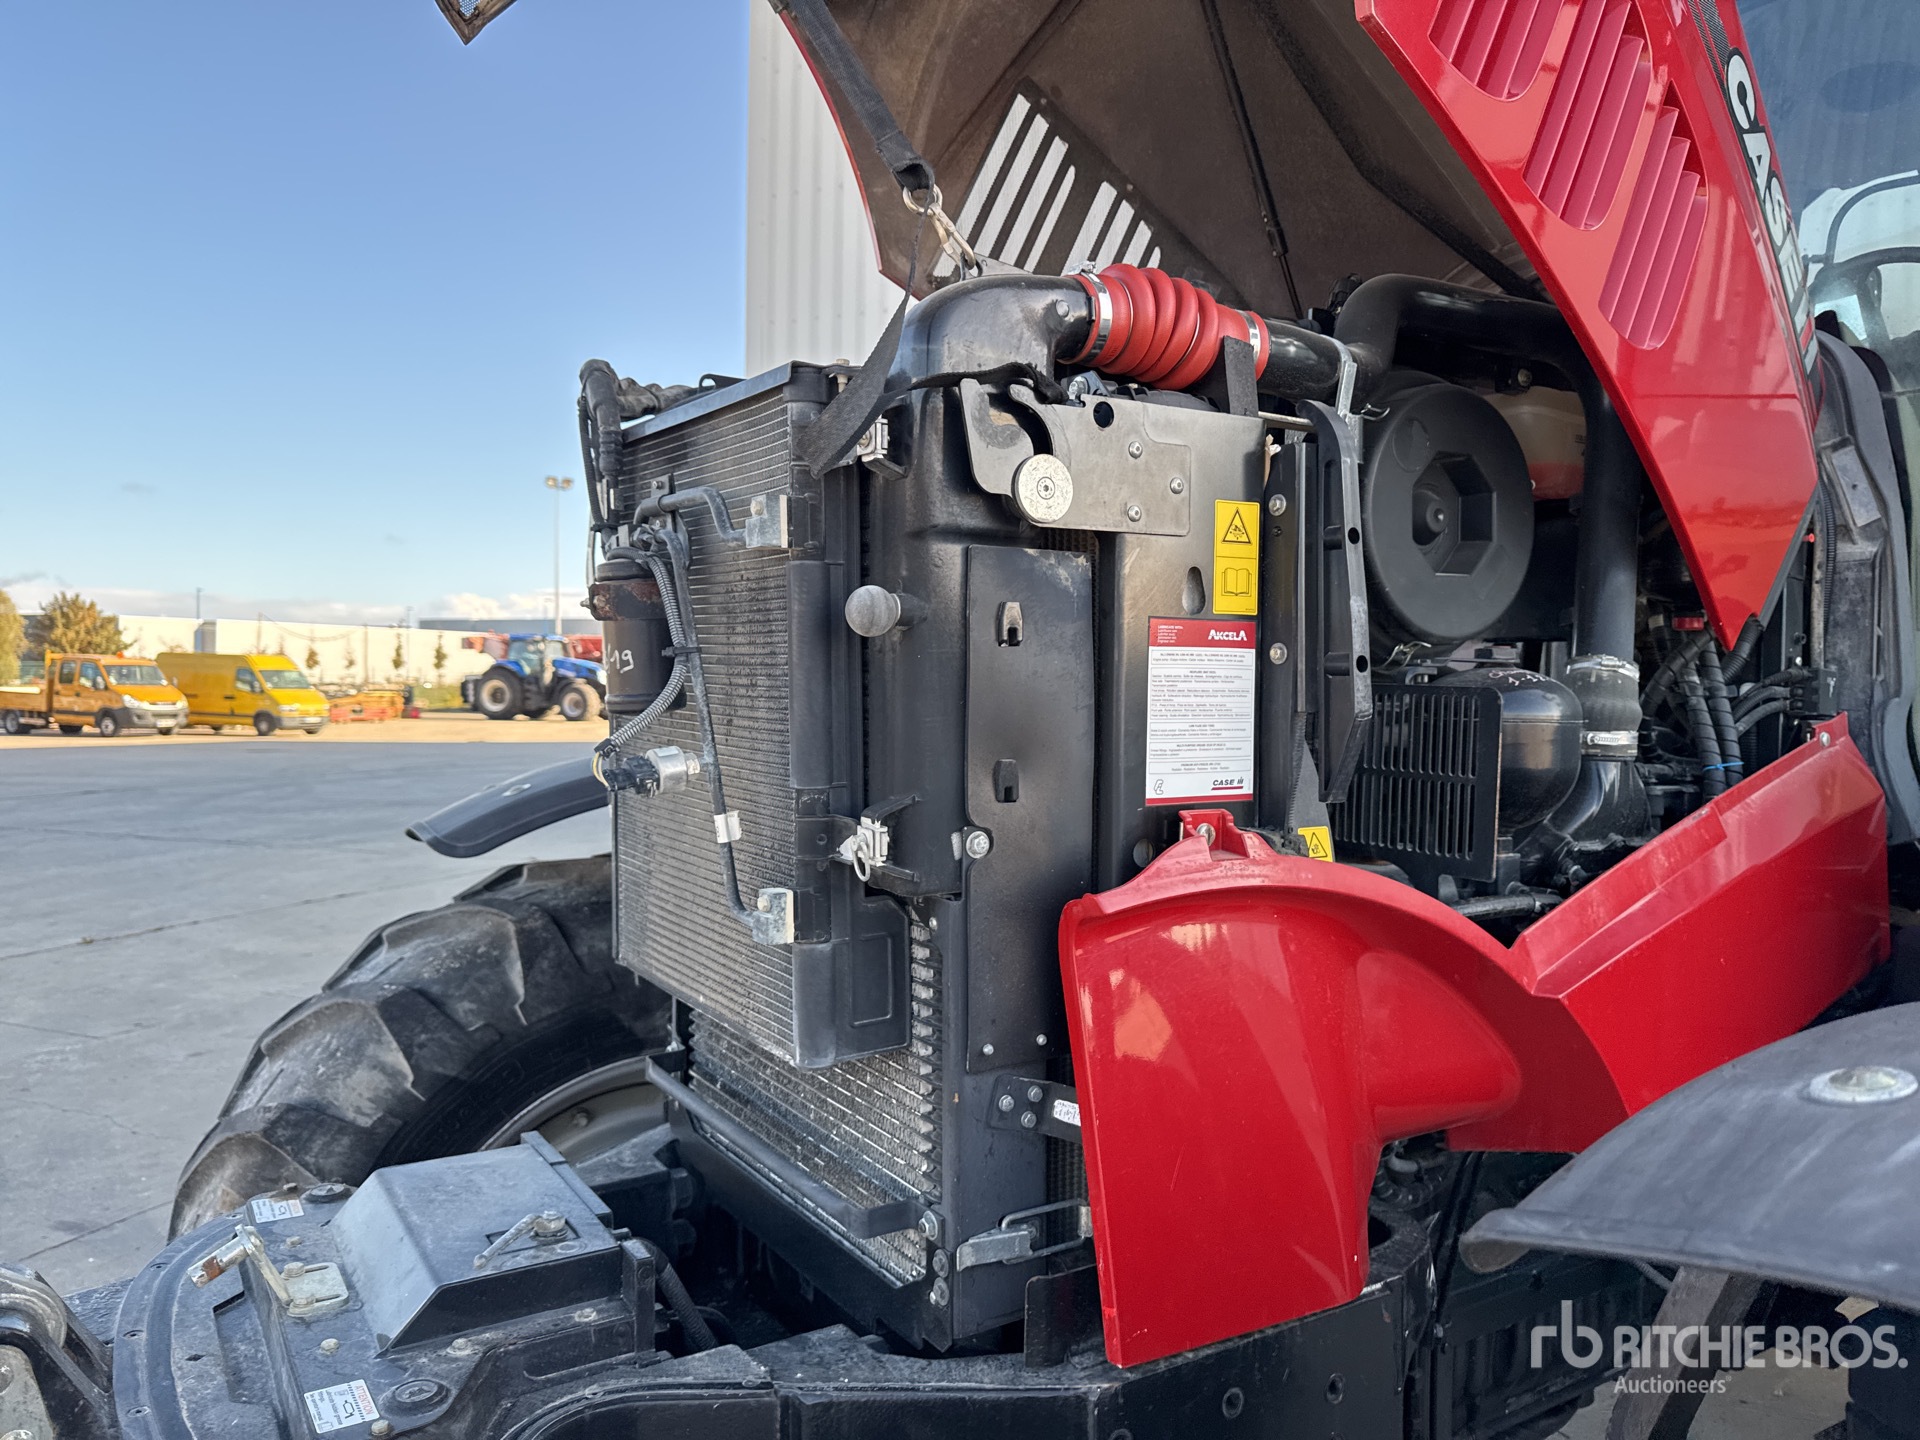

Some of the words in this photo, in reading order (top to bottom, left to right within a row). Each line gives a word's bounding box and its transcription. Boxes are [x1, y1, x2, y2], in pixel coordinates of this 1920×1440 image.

[1727, 54, 1801, 303] CASE
[1208, 629, 1247, 641] AKCELA
[1212, 778, 1235, 786] CASE
[355, 1385, 374, 1415] ATTENTION
